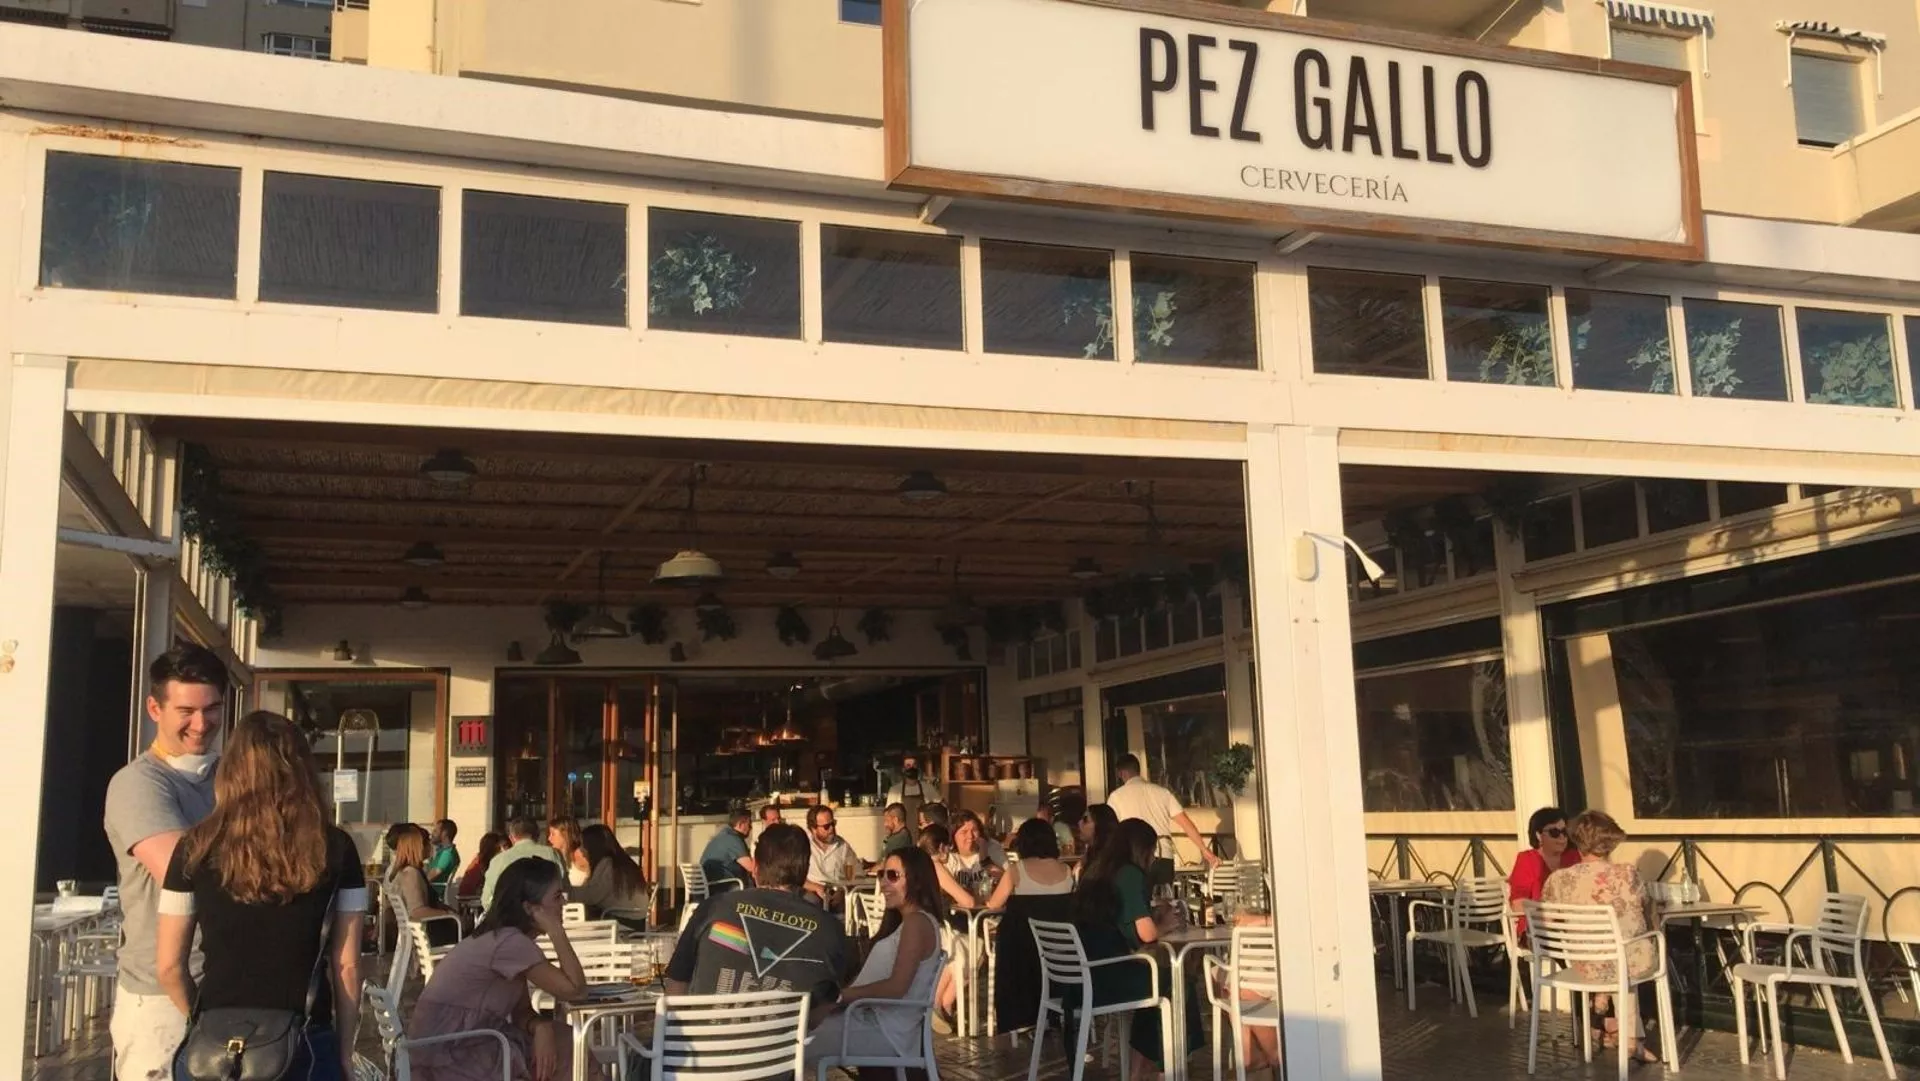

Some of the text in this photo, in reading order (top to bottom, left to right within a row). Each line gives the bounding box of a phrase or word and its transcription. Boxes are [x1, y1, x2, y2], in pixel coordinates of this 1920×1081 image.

[1140, 27, 1492, 169] PEZ GALLO
[1240, 165, 1408, 203] CERVECERÍA
[735, 902, 818, 931] PINK FLOYD
